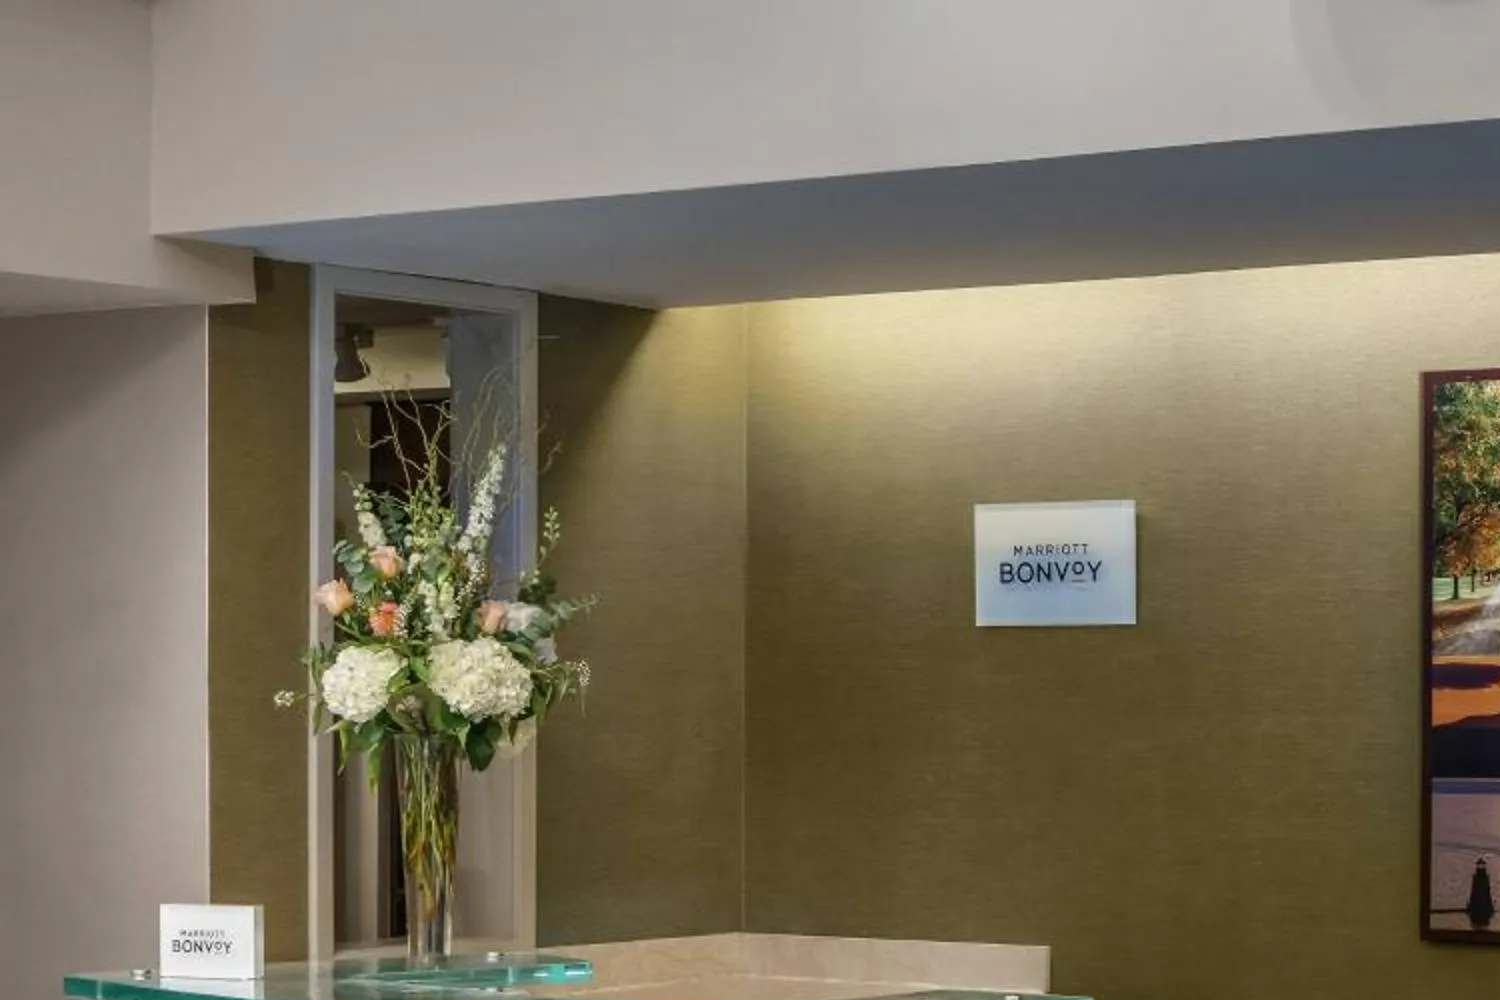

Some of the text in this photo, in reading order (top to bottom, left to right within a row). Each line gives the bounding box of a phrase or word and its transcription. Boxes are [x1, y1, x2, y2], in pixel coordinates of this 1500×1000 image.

[1013, 543, 1088, 556] MARRIOTT
[999, 560, 1102, 584] BONVOY
[171, 939, 233, 954] BONVOY
